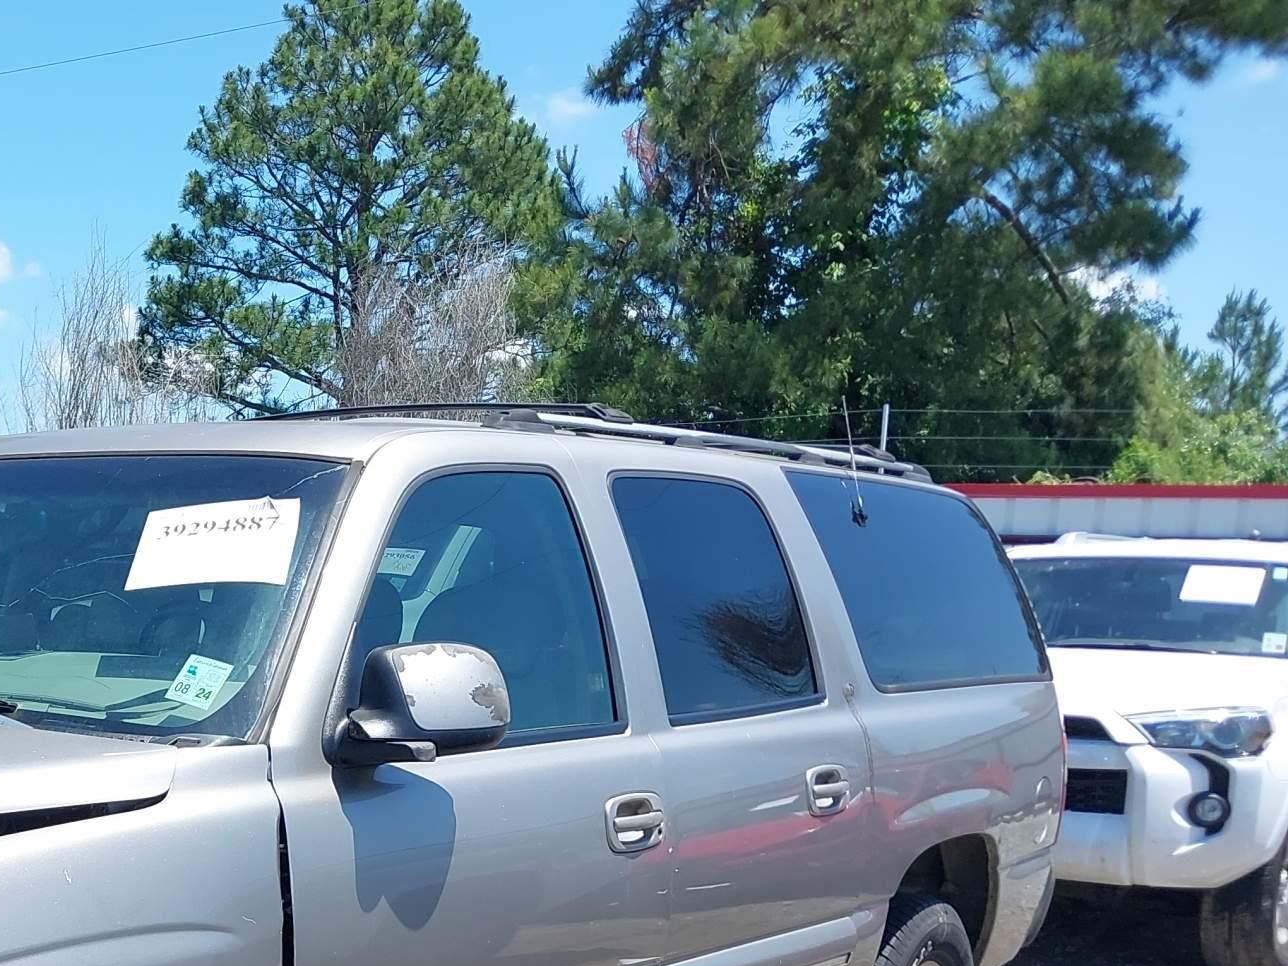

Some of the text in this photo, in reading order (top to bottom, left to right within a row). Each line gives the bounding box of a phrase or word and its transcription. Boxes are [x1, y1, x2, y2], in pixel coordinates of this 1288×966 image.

[158, 514, 281, 541] 39294887
[174, 681, 213, 701] 08 24
